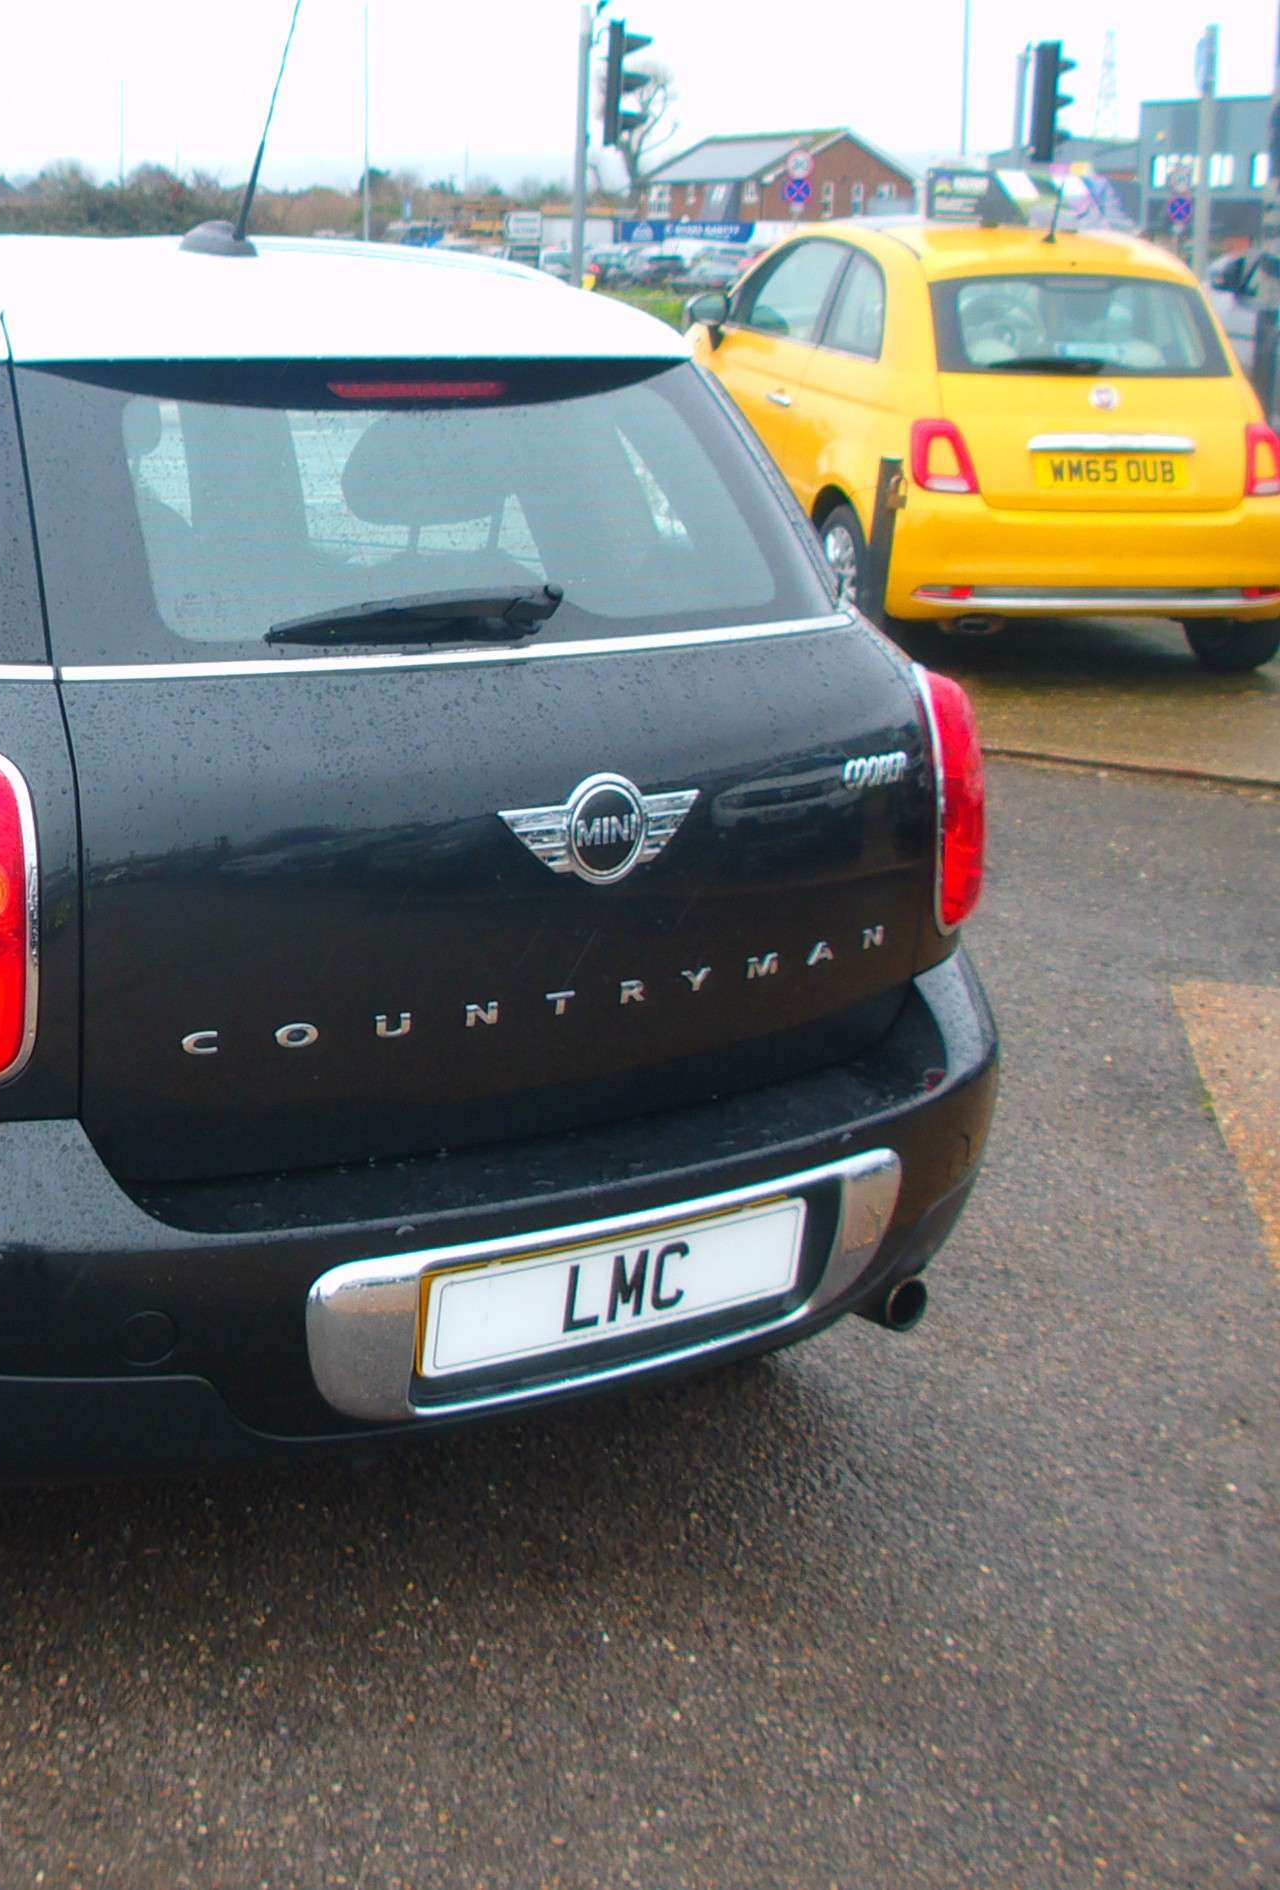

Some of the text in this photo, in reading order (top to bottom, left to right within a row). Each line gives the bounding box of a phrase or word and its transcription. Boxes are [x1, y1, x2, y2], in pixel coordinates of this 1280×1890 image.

[1049, 458, 1176, 484] WM65 OUB
[844, 751, 907, 791] COOPER
[576, 813, 637, 848] MINI
[181, 925, 885, 1056] COUNTRYMAN
[561, 1240, 691, 1334] LMC
